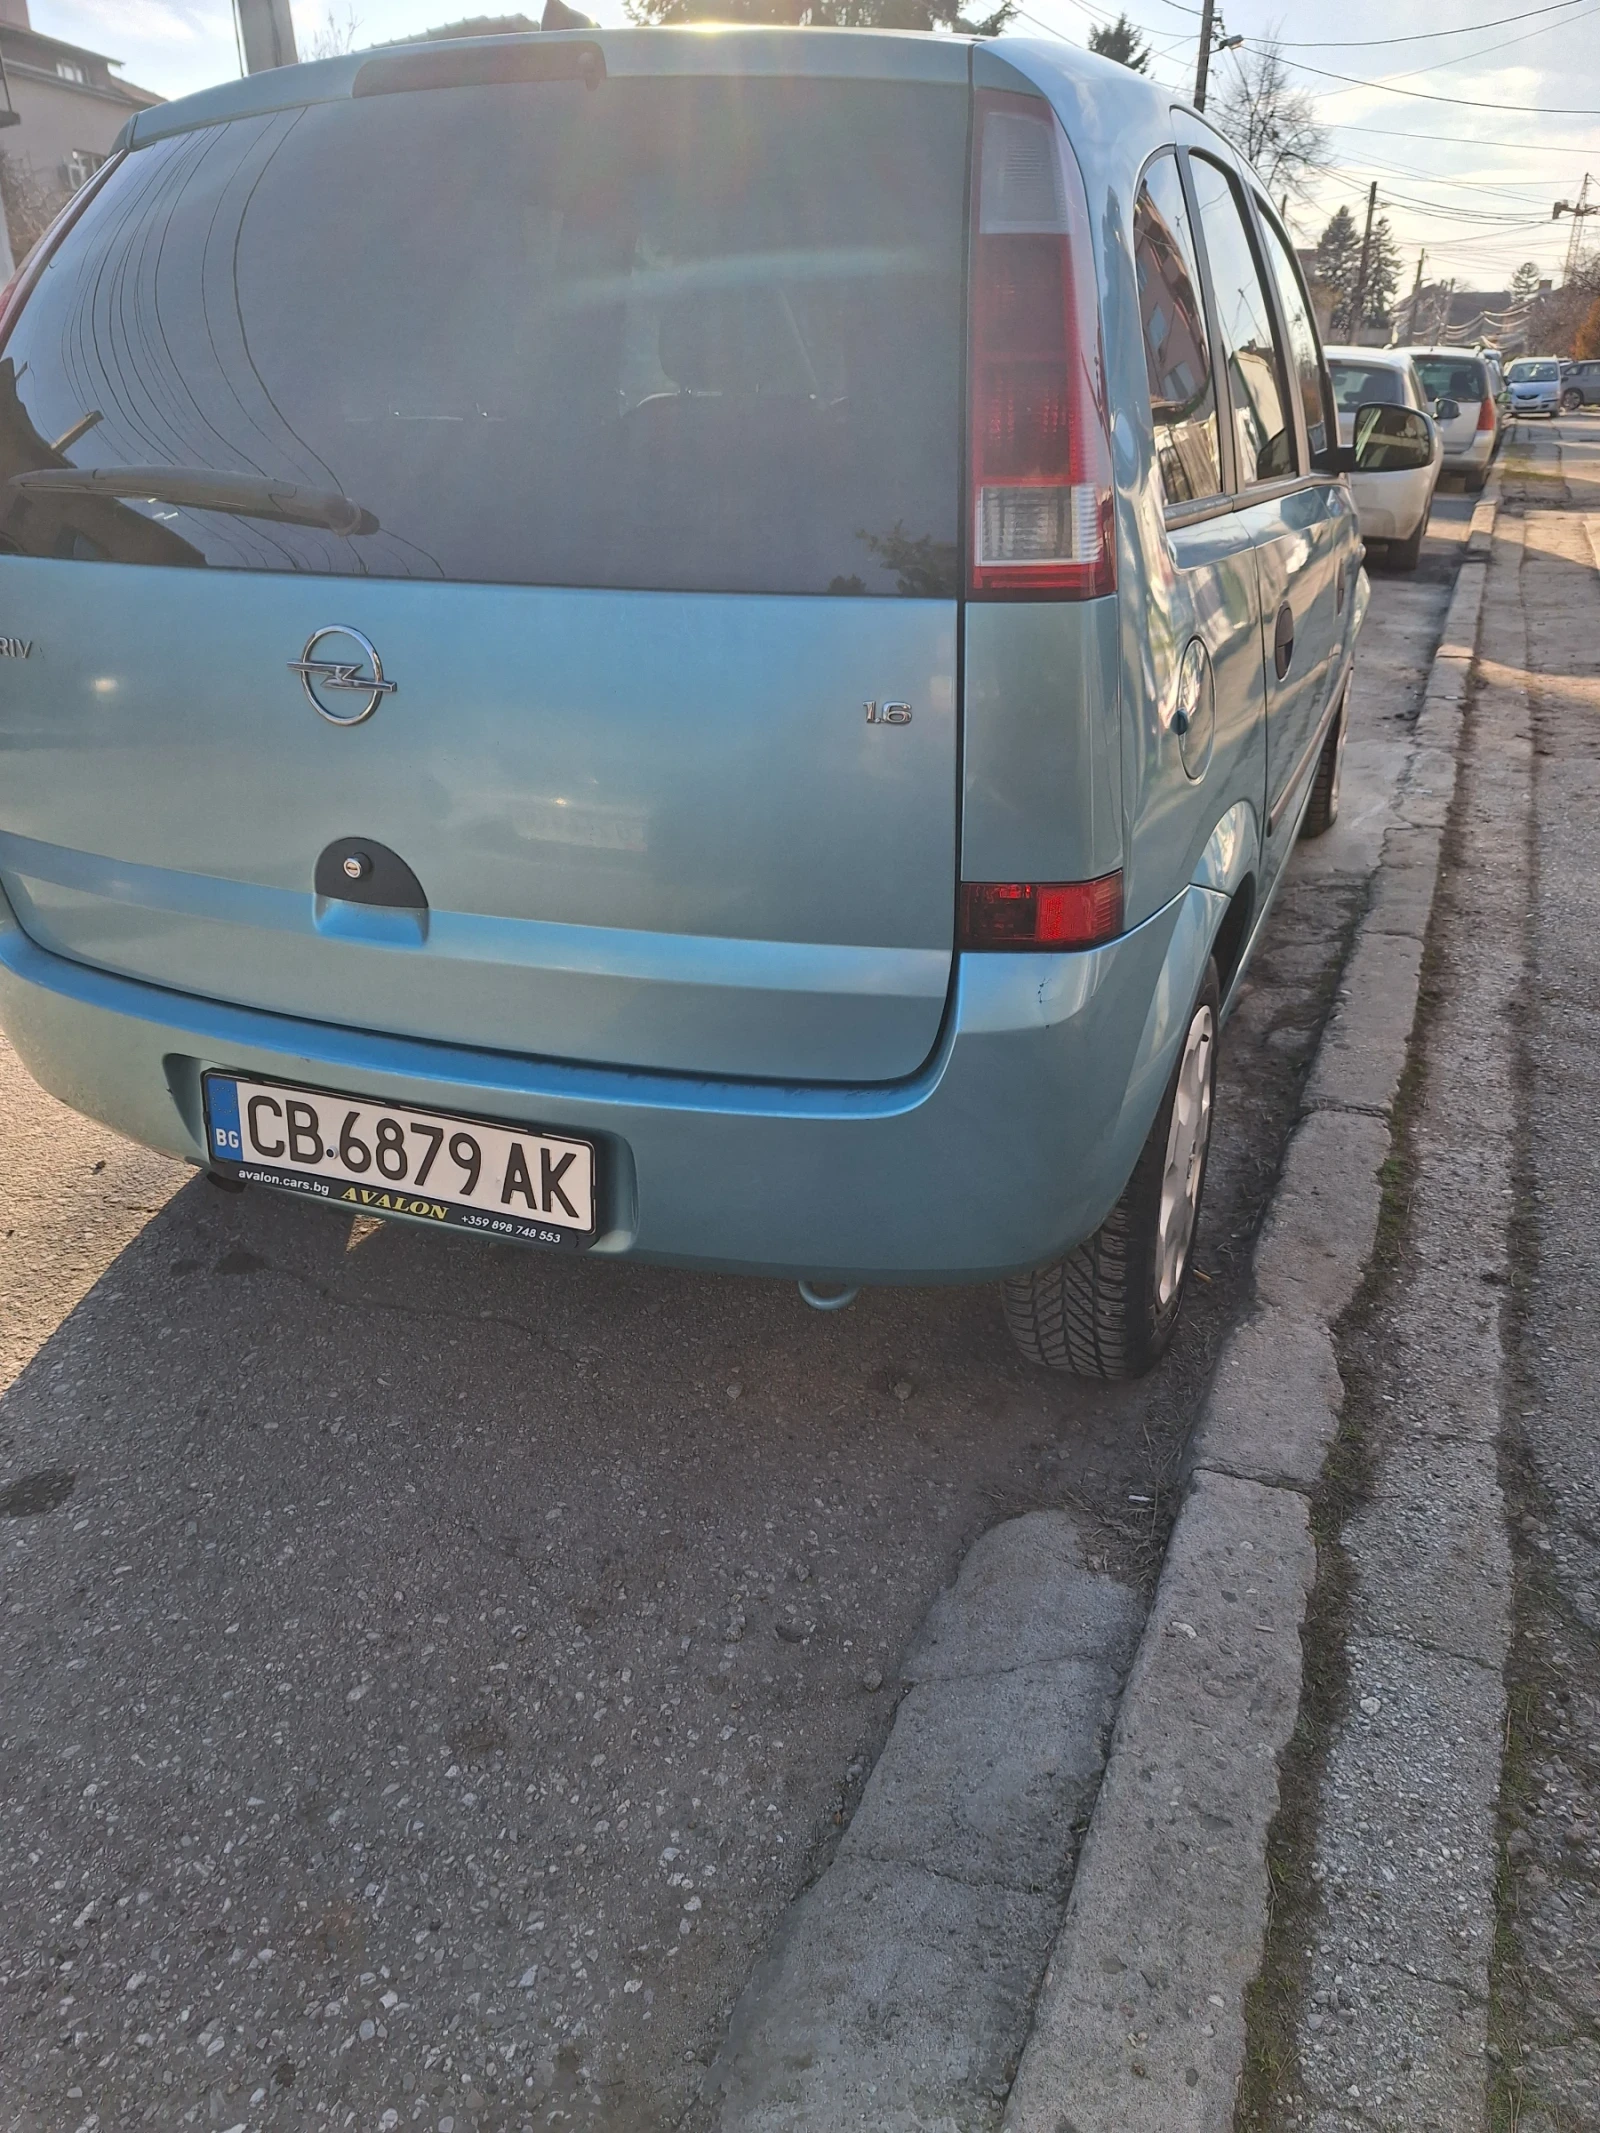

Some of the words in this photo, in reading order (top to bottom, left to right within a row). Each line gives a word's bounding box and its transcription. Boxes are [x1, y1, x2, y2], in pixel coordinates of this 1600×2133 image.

[863, 701, 912, 724] 1.6
[215, 1128, 239, 1148] BG
[247, 1095, 324, 1164] CB
[339, 1111, 482, 1196] 6879
[500, 1142, 580, 1219] AK
[238, 1169, 330, 1196] avalon.cars.bg
[341, 1187, 450, 1219] AVALON
[461, 1215, 490, 1227] +359
[491, 1220, 513, 1233] 898
[515, 1225, 537, 1238] 748
[538, 1230, 561, 1244] 553
